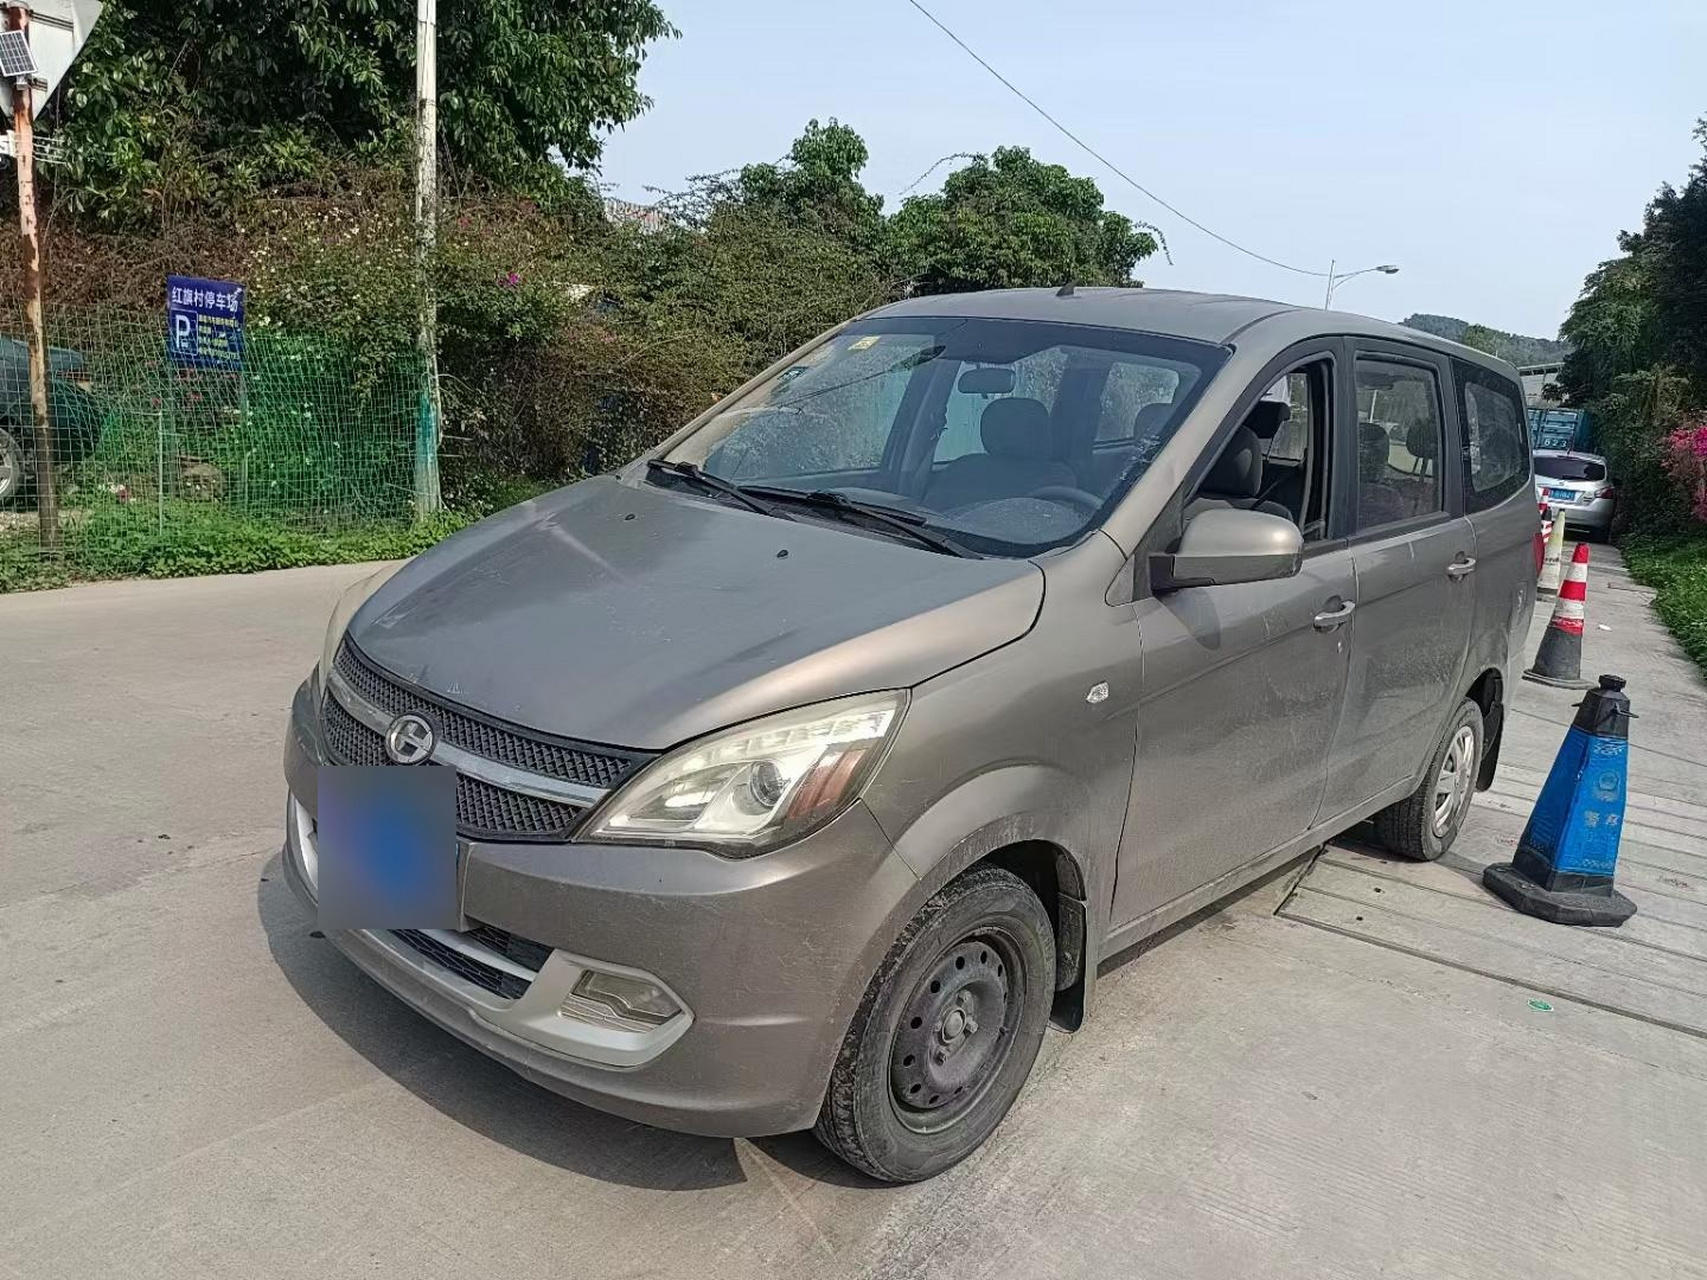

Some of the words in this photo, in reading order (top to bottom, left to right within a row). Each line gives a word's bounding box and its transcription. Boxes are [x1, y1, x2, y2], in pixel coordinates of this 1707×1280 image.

[172, 286, 239, 312] 红旗村停车场
[175, 314, 190, 348] P
